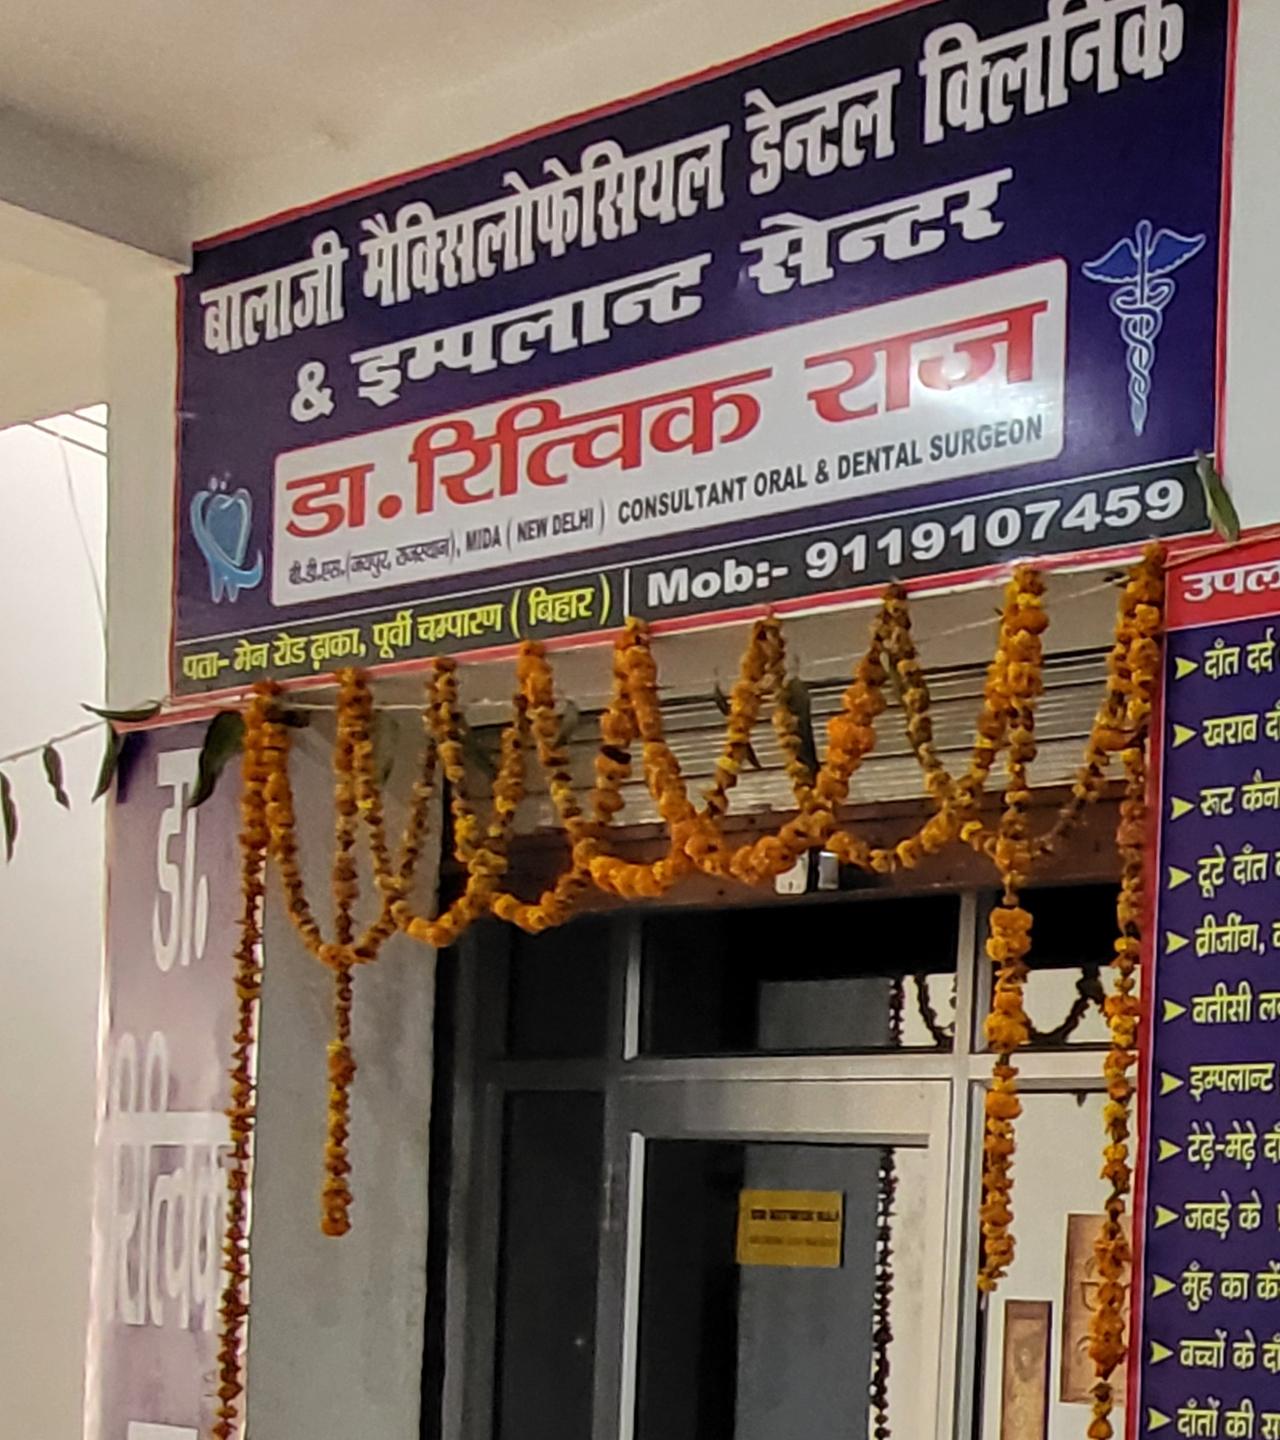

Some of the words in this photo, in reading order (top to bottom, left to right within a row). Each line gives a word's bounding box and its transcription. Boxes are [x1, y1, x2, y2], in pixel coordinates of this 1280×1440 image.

[200, 230, 349, 355] बालाजी
[745, 68, 900, 194] डेन्टल
[289, 361, 334, 421] &
[741, 168, 1012, 294] सेन्टर
[807, 297, 1049, 423] राज
[466, 524, 502, 552] MIDA
[618, 478, 747, 525] CONSULTANT
[753, 465, 807, 496] ORAL
[816, 461, 831, 483] &
[838, 440, 923, 481] DENTAL
[930, 415, 1043, 463] SURGEON
[647, 554, 788, 608] Mob:-
[805, 478, 1184, 579] 9119107459
[235, 640, 268, 672] मेन
[274, 635, 307, 666] रोड
[1203, 713, 1257, 748] खराब
[1232, 841, 1268, 884] दाँत
